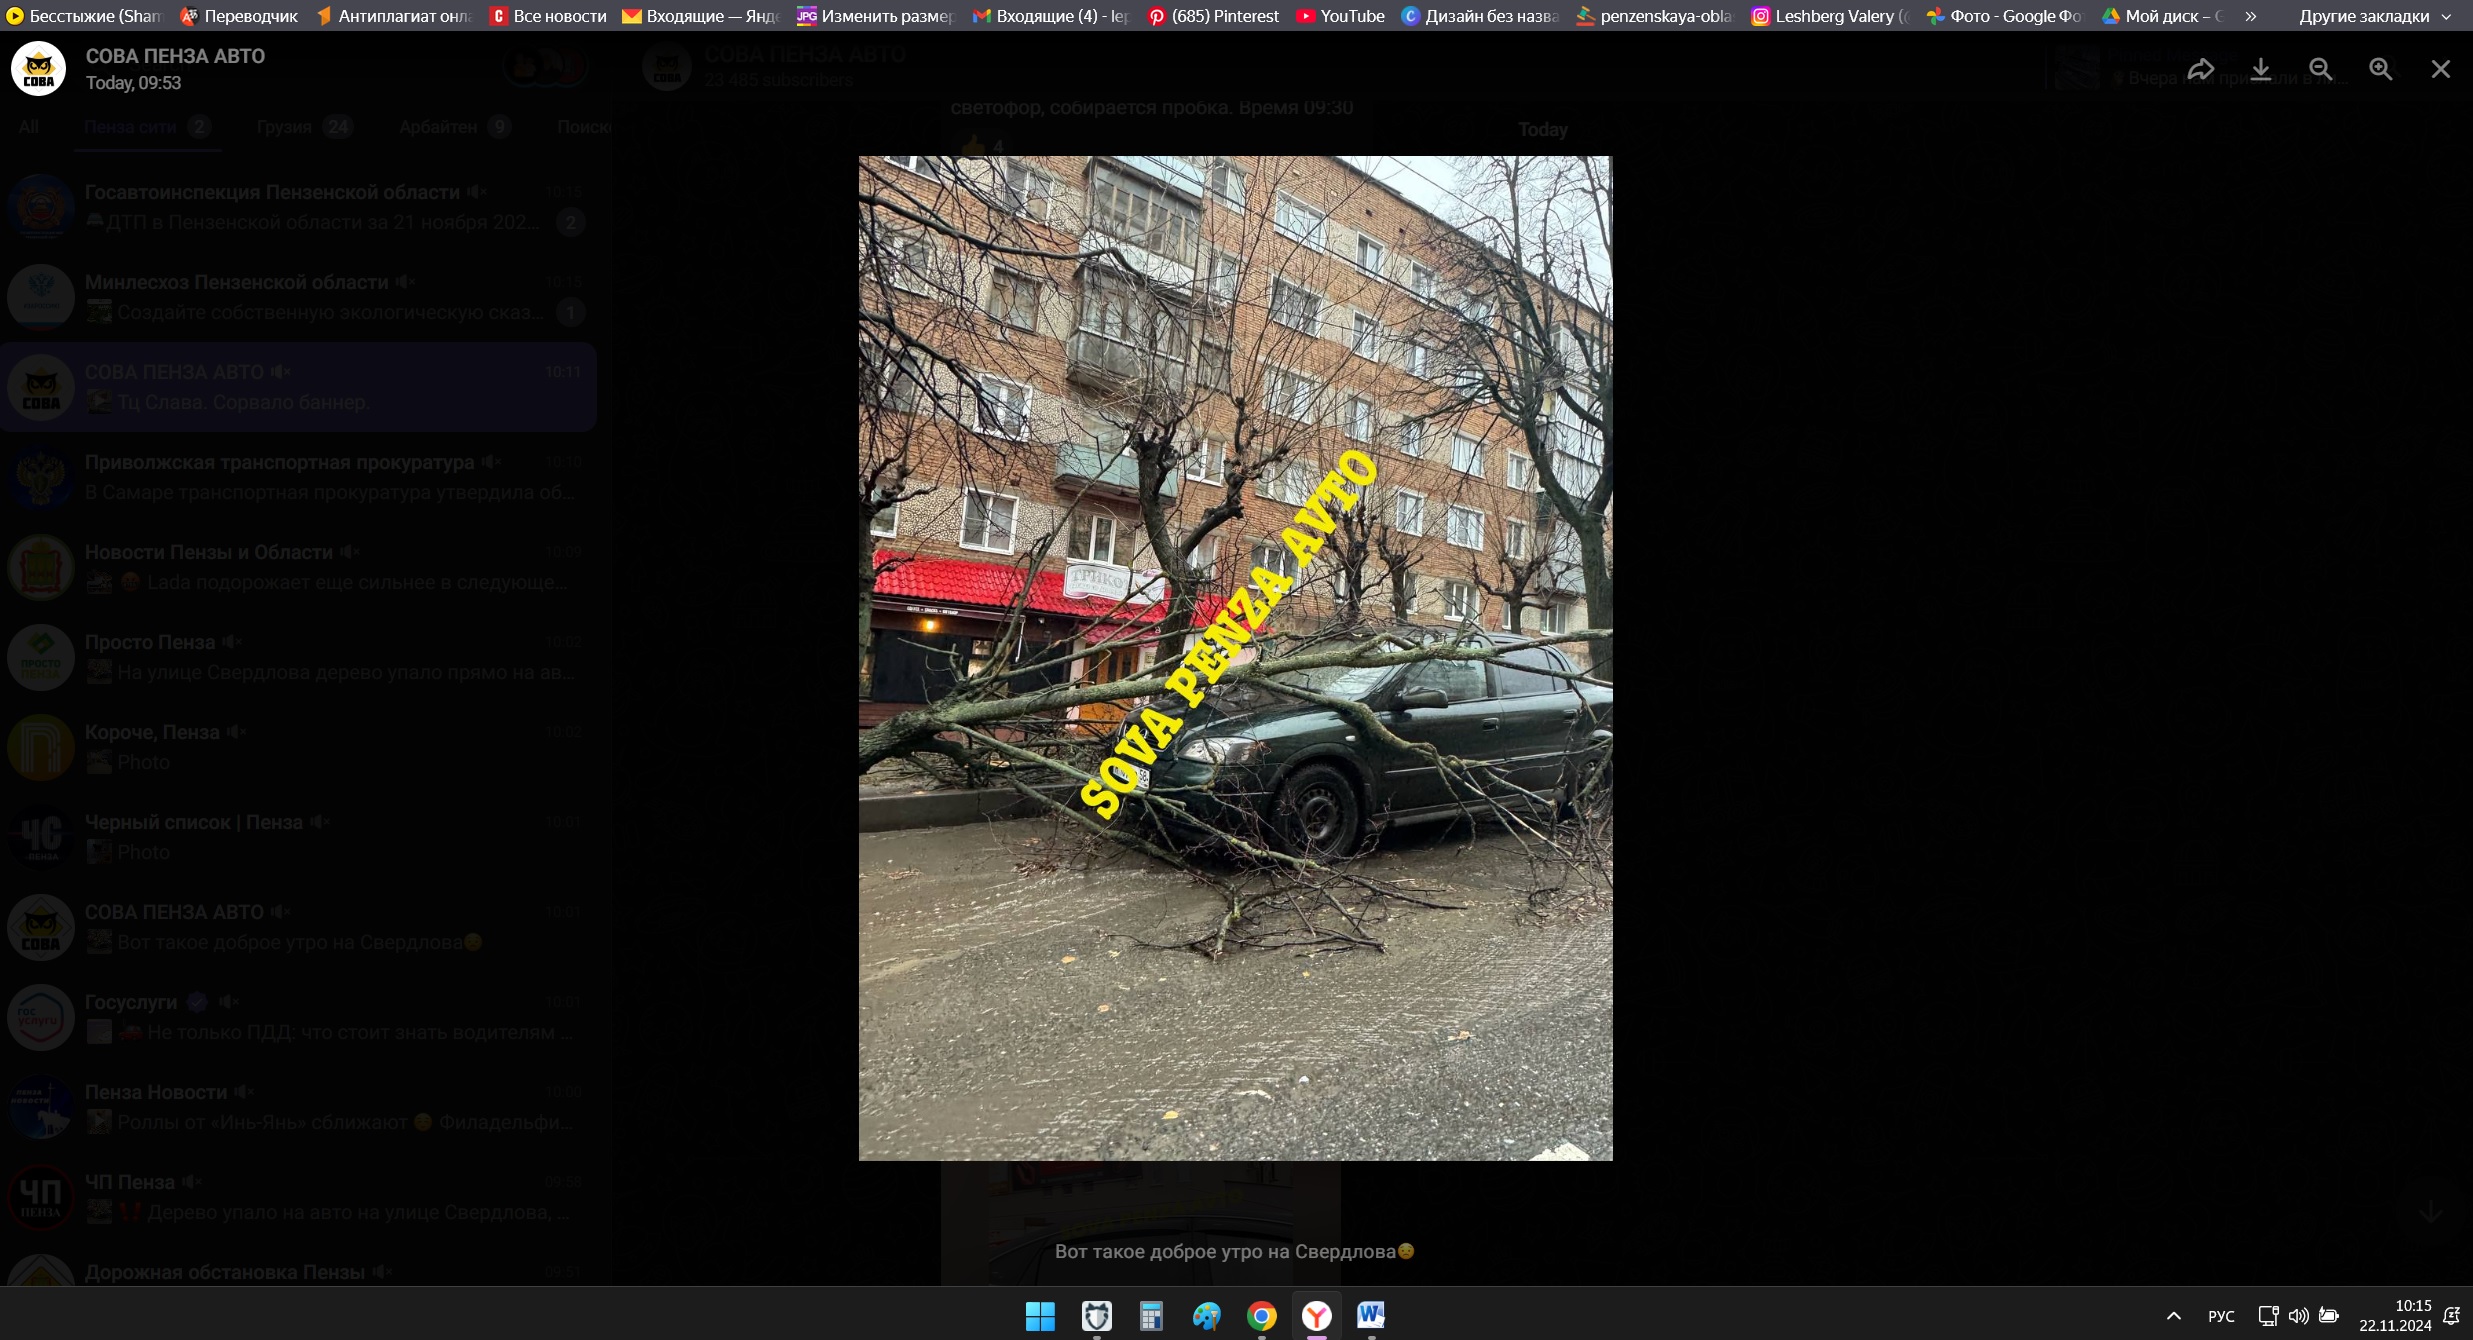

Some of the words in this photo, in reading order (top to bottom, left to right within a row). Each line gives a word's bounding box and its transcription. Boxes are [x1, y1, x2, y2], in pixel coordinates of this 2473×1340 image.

[31, 10, 115, 22] Бесстыжие
[206, 10, 298, 25] Переводчик
[339, 10, 437, 22] Антиплагиат
[515, 10, 541, 22] Все
[546, 13, 606, 22] новости
[648, 10, 724, 24] Входящие
[797, 12, 817, 21] JPG
[823, 10, 898, 22] Изменить
[998, 10, 1074, 24] Входящие
[1079, 9, 1097, 24] (4)
[1172, 9, 1210, 24] (685)
[1215, 10, 1279, 22] Pinterest
[1321, 10, 1385, 22] YouTube
[1426, 10, 1483, 25] Дизайн
[1487, 9, 1513, 22] без
[1777, 10, 1844, 25] Leshberg
[1848, 10, 1895, 25] Valery
[1951, 10, 1990, 22] Фото
[2003, 10, 2056, 25] Google
[2127, 10, 2158, 22] Мой
[2163, 13, 2199, 24] диск
[2300, 10, 2356, 25] Другие
[2360, 13, 2429, 24] закладки
[87, 48, 139, 63] СОВА
[145, 48, 209, 63] ПЕНЗА
[214, 48, 265, 63] АВТО
[24, 77, 54, 86] СОВА
[86, 75, 134, 93] Today,
[139, 76, 181, 89] 09:53
[19, 119, 38, 133] All
[85, 120, 134, 134] Пенза
[139, 123, 176, 134] сити
[258, 120, 311, 137] Грузия
[329, 120, 347, 133] 24
[400, 119, 477, 137] Арбайтен
[86, 184, 260, 203] Госавтоинспекция
[267, 184, 378, 200] Пензенской
[384, 184, 459, 200] области
[106, 215, 146, 233] ДТП
[170, 214, 280, 229] Пензенской
[287, 214, 361, 230] области
[368, 218, 387, 229] за
[394, 214, 412, 229] 21
[422, 214, 487, 233] ноября
[86, 274, 189, 289] Минлесхоз
[195, 274, 306, 289] Пензенской
[312, 274, 388, 290] области
[118, 304, 206, 323] Создайте
[211, 304, 334, 323] собственную
[340, 308, 483, 324] экологическую
[86, 364, 137, 379] СОВА
[144, 364, 207, 379] ПЕНЗА
[213, 364, 263, 379] АВТО
[546, 366, 579, 377] 10:11
[118, 394, 140, 412] Тц
[146, 394, 207, 409] Слава.
[214, 394, 293, 413] Сорвало
[300, 397, 370, 413] баннер.
[86, 454, 214, 473] Приволжская
[220, 458, 350, 473] транспортная
[357, 458, 474, 474] прокуратура
[103, 484, 173, 503] Самаре
[179, 488, 308, 503] транспортная
[315, 488, 430, 503] прокуратура
[437, 488, 533, 503] утвердила
[86, 544, 164, 560] Новости
[171, 544, 231, 559] Пензы
[255, 544, 332, 560] Области
[86, 635, 153, 653] Просто
[159, 635, 215, 649] Пенза
[119, 664, 141, 679] На
[148, 668, 201, 683] улице
[208, 664, 309, 683] Свердлова
[316, 668, 382, 683] дерево
[388, 668, 442, 683] упало
[449, 668, 507, 683] прямо
[514, 668, 534, 679] на
[86, 724, 157, 743] Короче,
[164, 724, 220, 740] Пенза
[119, 754, 170, 769] Photo
[86, 814, 159, 833] Черный
[165, 818, 231, 829] список
[247, 815, 303, 830] Пенза
[119, 844, 170, 859] Photo
[86, 904, 138, 919] СОВА
[144, 904, 208, 919] ПЕНЗА
[213, 904, 264, 919] АВТО
[119, 935, 151, 949] Вот
[156, 938, 208, 949] такое
[214, 934, 280, 953] доброе
[286, 938, 327, 953] утро
[334, 938, 354, 949] на
[361, 934, 462, 953] Свердлова
[86, 995, 177, 1013] Госуслуги
[86, 1085, 142, 1099] Пенза
[148, 1085, 227, 1099] Новости
[86, 1174, 112, 1189] ЧП
[119, 1174, 175, 1189] Пенза
[148, 1205, 217, 1223] Дерево
[223, 1208, 277, 1223] упало
[284, 1208, 304, 1219] на
[310, 1208, 352, 1219] авто
[358, 1208, 379, 1219] на
[385, 1208, 439, 1223] улице
[445, 1204, 551, 1223] Свердлова,
[1056, 1244, 1088, 1258] Вот
[1093, 1248, 1144, 1258] такое
[1150, 1243, 1216, 1262] доброе
[1222, 1248, 1262, 1262] утро
[1269, 1248, 1289, 1258] на
[1296, 1244, 1395, 1262] Свердлова
[85, 1264, 182, 1283] Дорожная
[189, 1264, 297, 1279] обстановка
[304, 1264, 364, 1279] Пензы
[2397, 1300, 2431, 1311] 10:15
[2209, 1311, 2234, 1322] РУС
[2360, 1320, 2432, 1331] 22.11.2024
